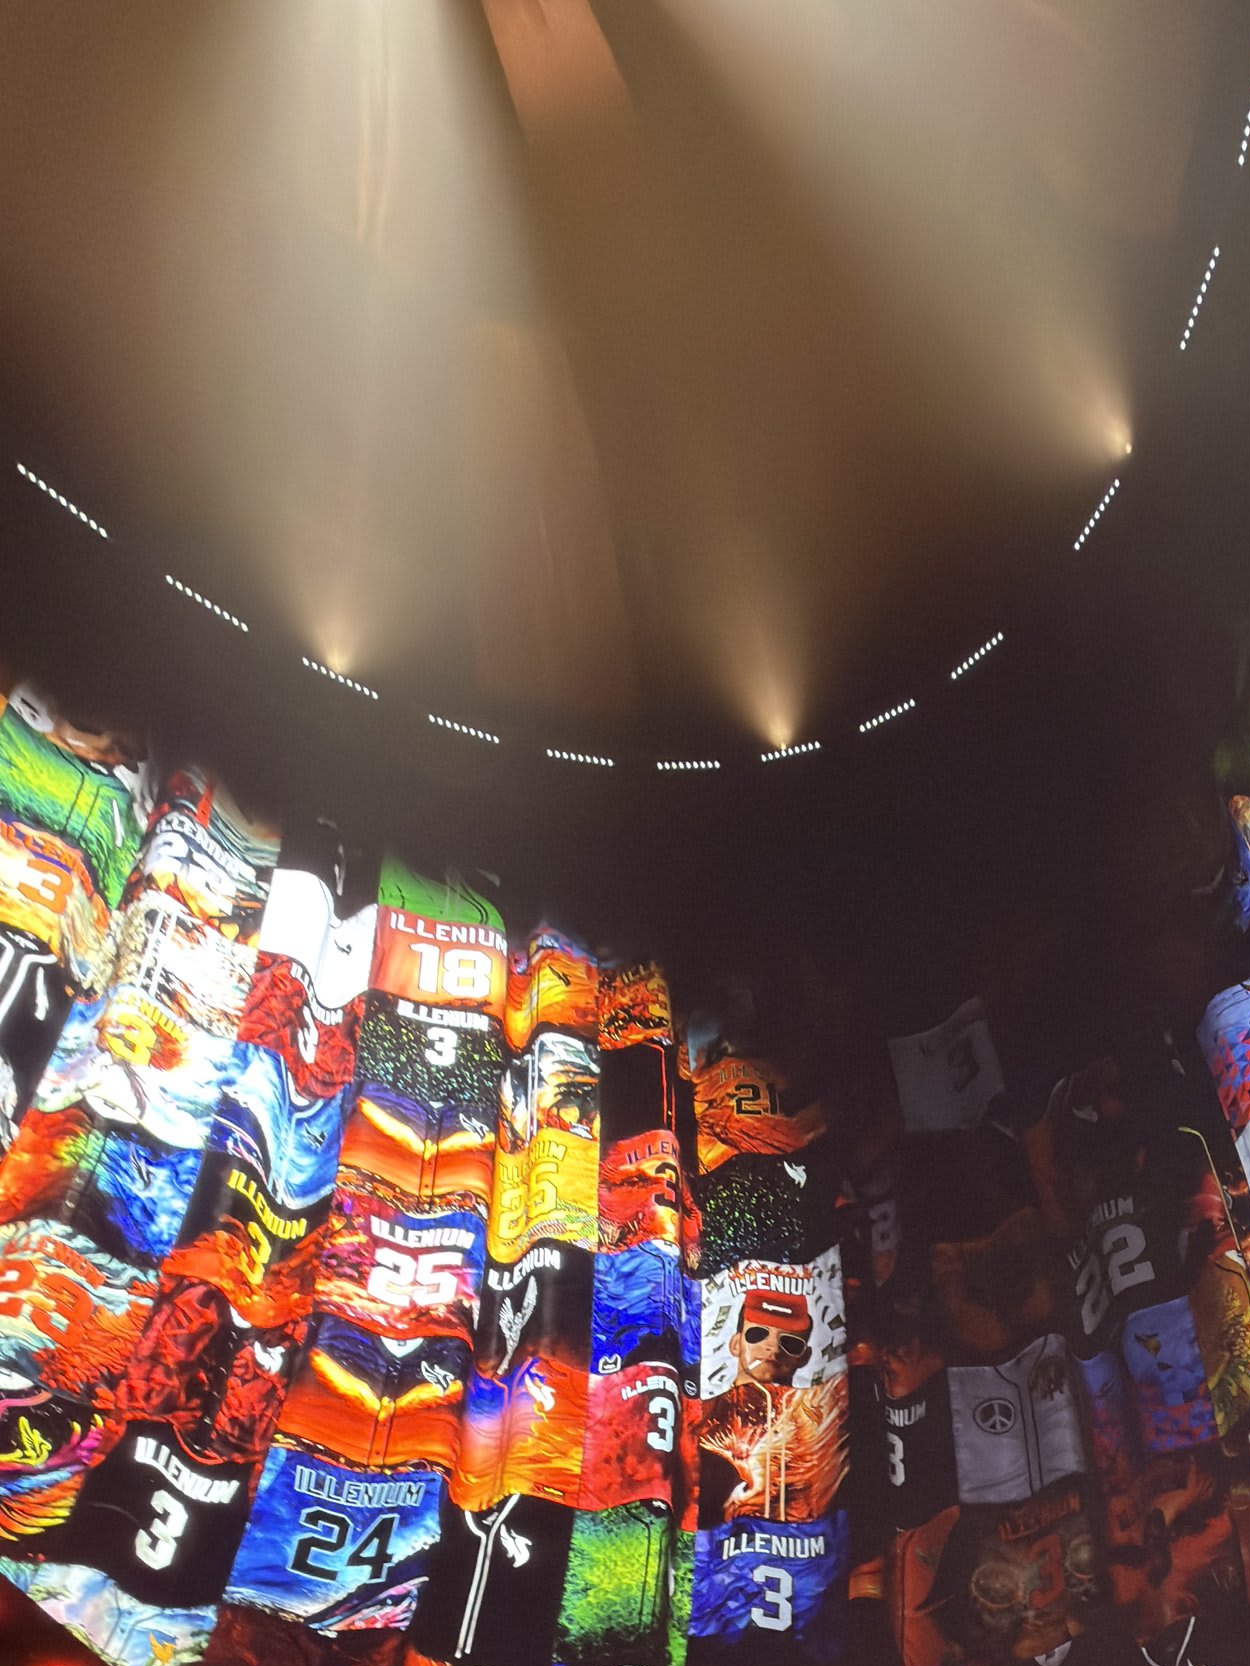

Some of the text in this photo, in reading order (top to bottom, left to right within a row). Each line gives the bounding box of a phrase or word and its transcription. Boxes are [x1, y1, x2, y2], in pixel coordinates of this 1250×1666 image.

[17, 857, 72, 913] 3
[410, 943, 492, 1000] 18
[398, 1001, 489, 1031] ILLENIUM
[426, 1027, 457, 1067] 3
[227, 1170, 306, 1240] ILLENIUM
[372, 1217, 475, 1249] ILLENIUM
[367, 1247, 462, 1306] 25
[488, 1248, 561, 1291] ILLENIUM
[731, 1272, 815, 1298] ILLENIUM
[648, 1397, 675, 1453] 3
[136, 1437, 239, 1503] ILLENIUM
[296, 1464, 425, 1508] ILLENIUM
[888, 1431, 905, 1486] 3
[136, 1490, 188, 1571] 3
[287, 1508, 400, 1582] 24
[724, 1533, 825, 1559] ILLENIUM
[751, 1564, 792, 1633] 3
